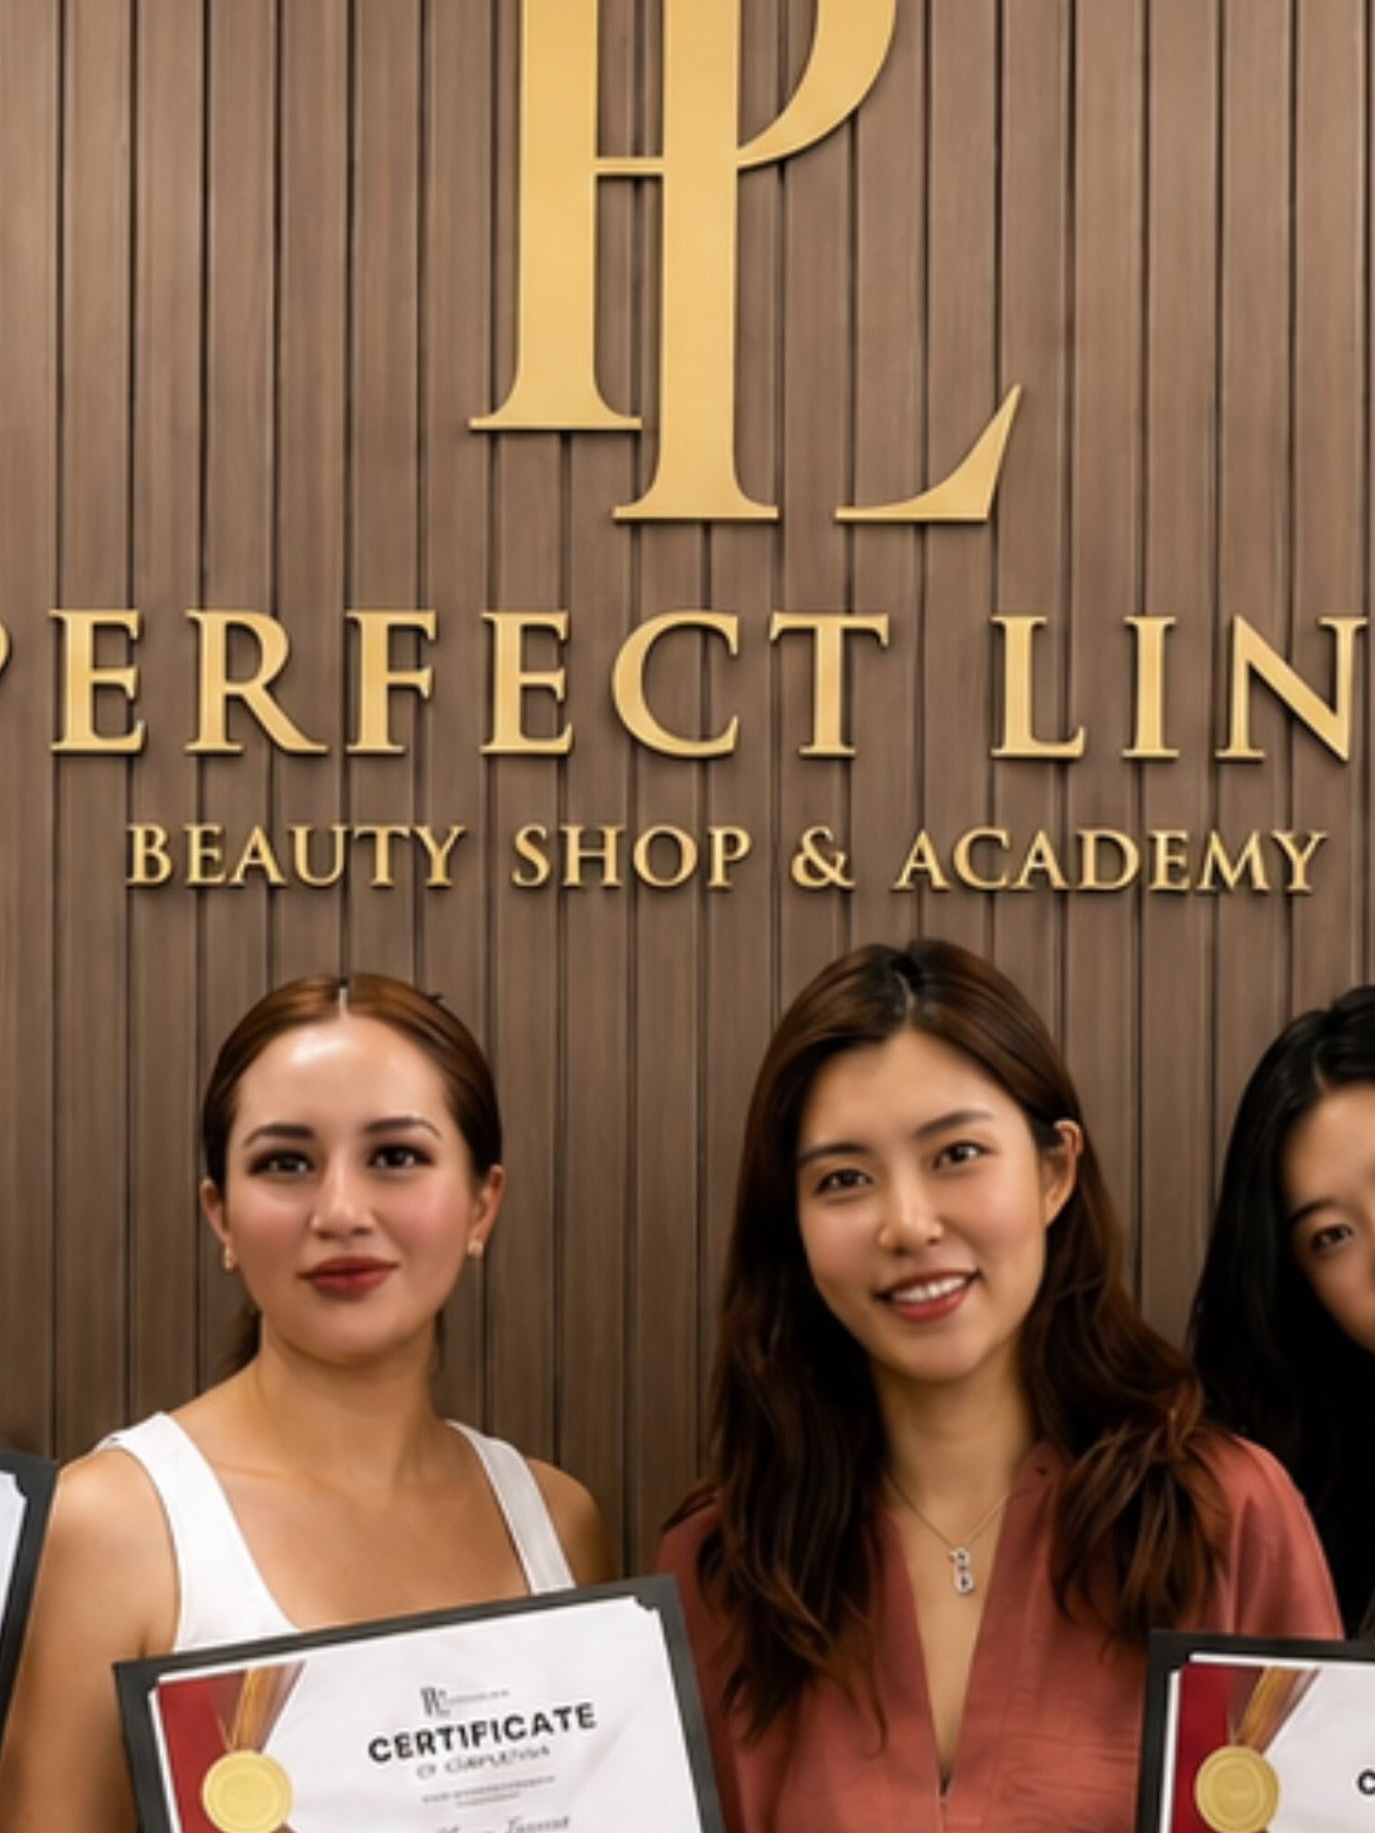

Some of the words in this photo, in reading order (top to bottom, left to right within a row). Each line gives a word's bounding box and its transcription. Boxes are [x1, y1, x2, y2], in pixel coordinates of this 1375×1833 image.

[127, 823, 467, 888] BEAUTY
[513, 825, 754, 890] SHOP
[792, 828, 853, 891] &
[893, 828, 1327, 896] ACADEMY
[368, 1702, 597, 1763] CERTIFICATE
